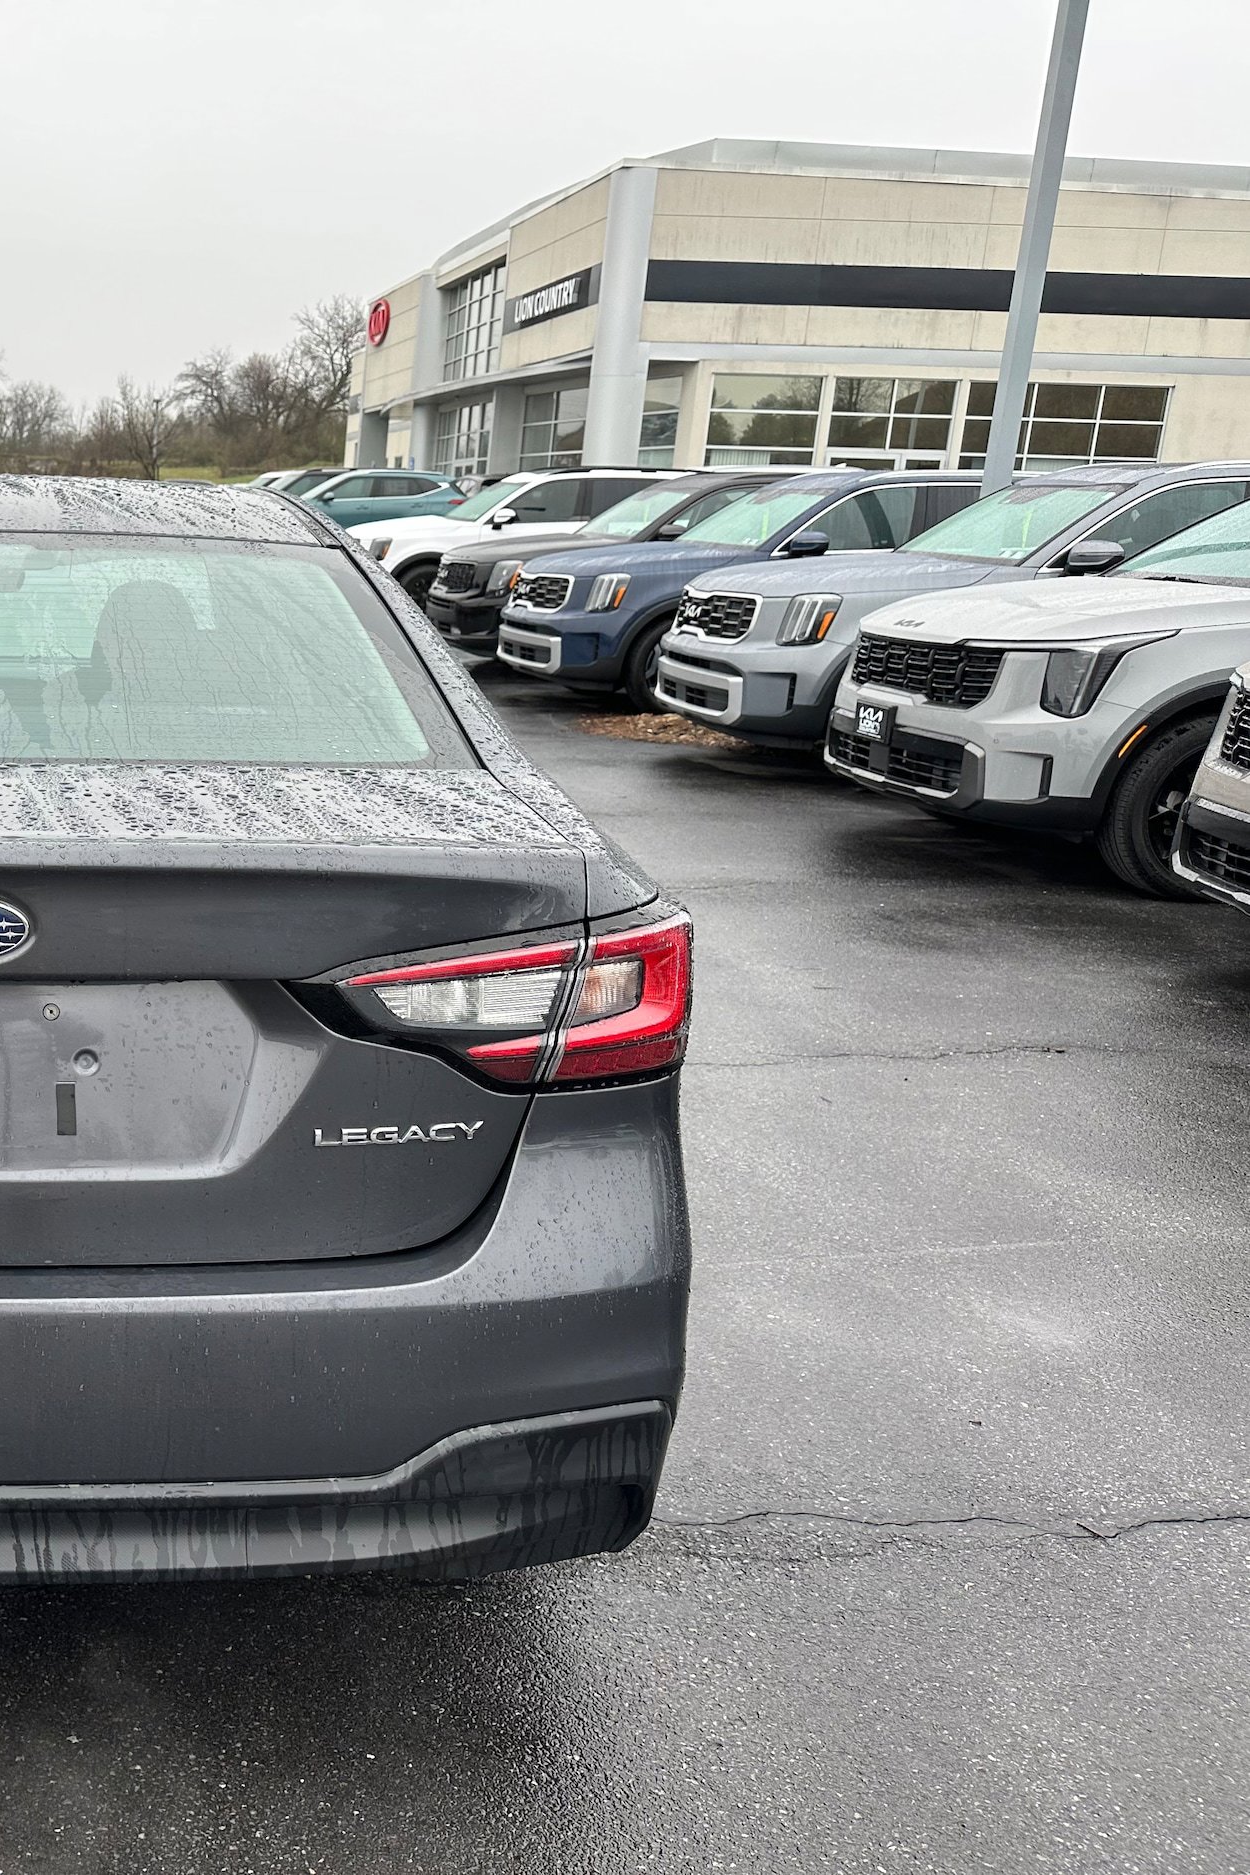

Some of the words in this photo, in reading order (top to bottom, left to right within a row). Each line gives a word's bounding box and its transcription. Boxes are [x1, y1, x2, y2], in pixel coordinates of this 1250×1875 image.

[514, 293, 535, 323] LION
[534, 277, 577, 317] COUNTRY
[859, 706, 883, 723] KIA
[313, 1120, 485, 1147] LEGACY
